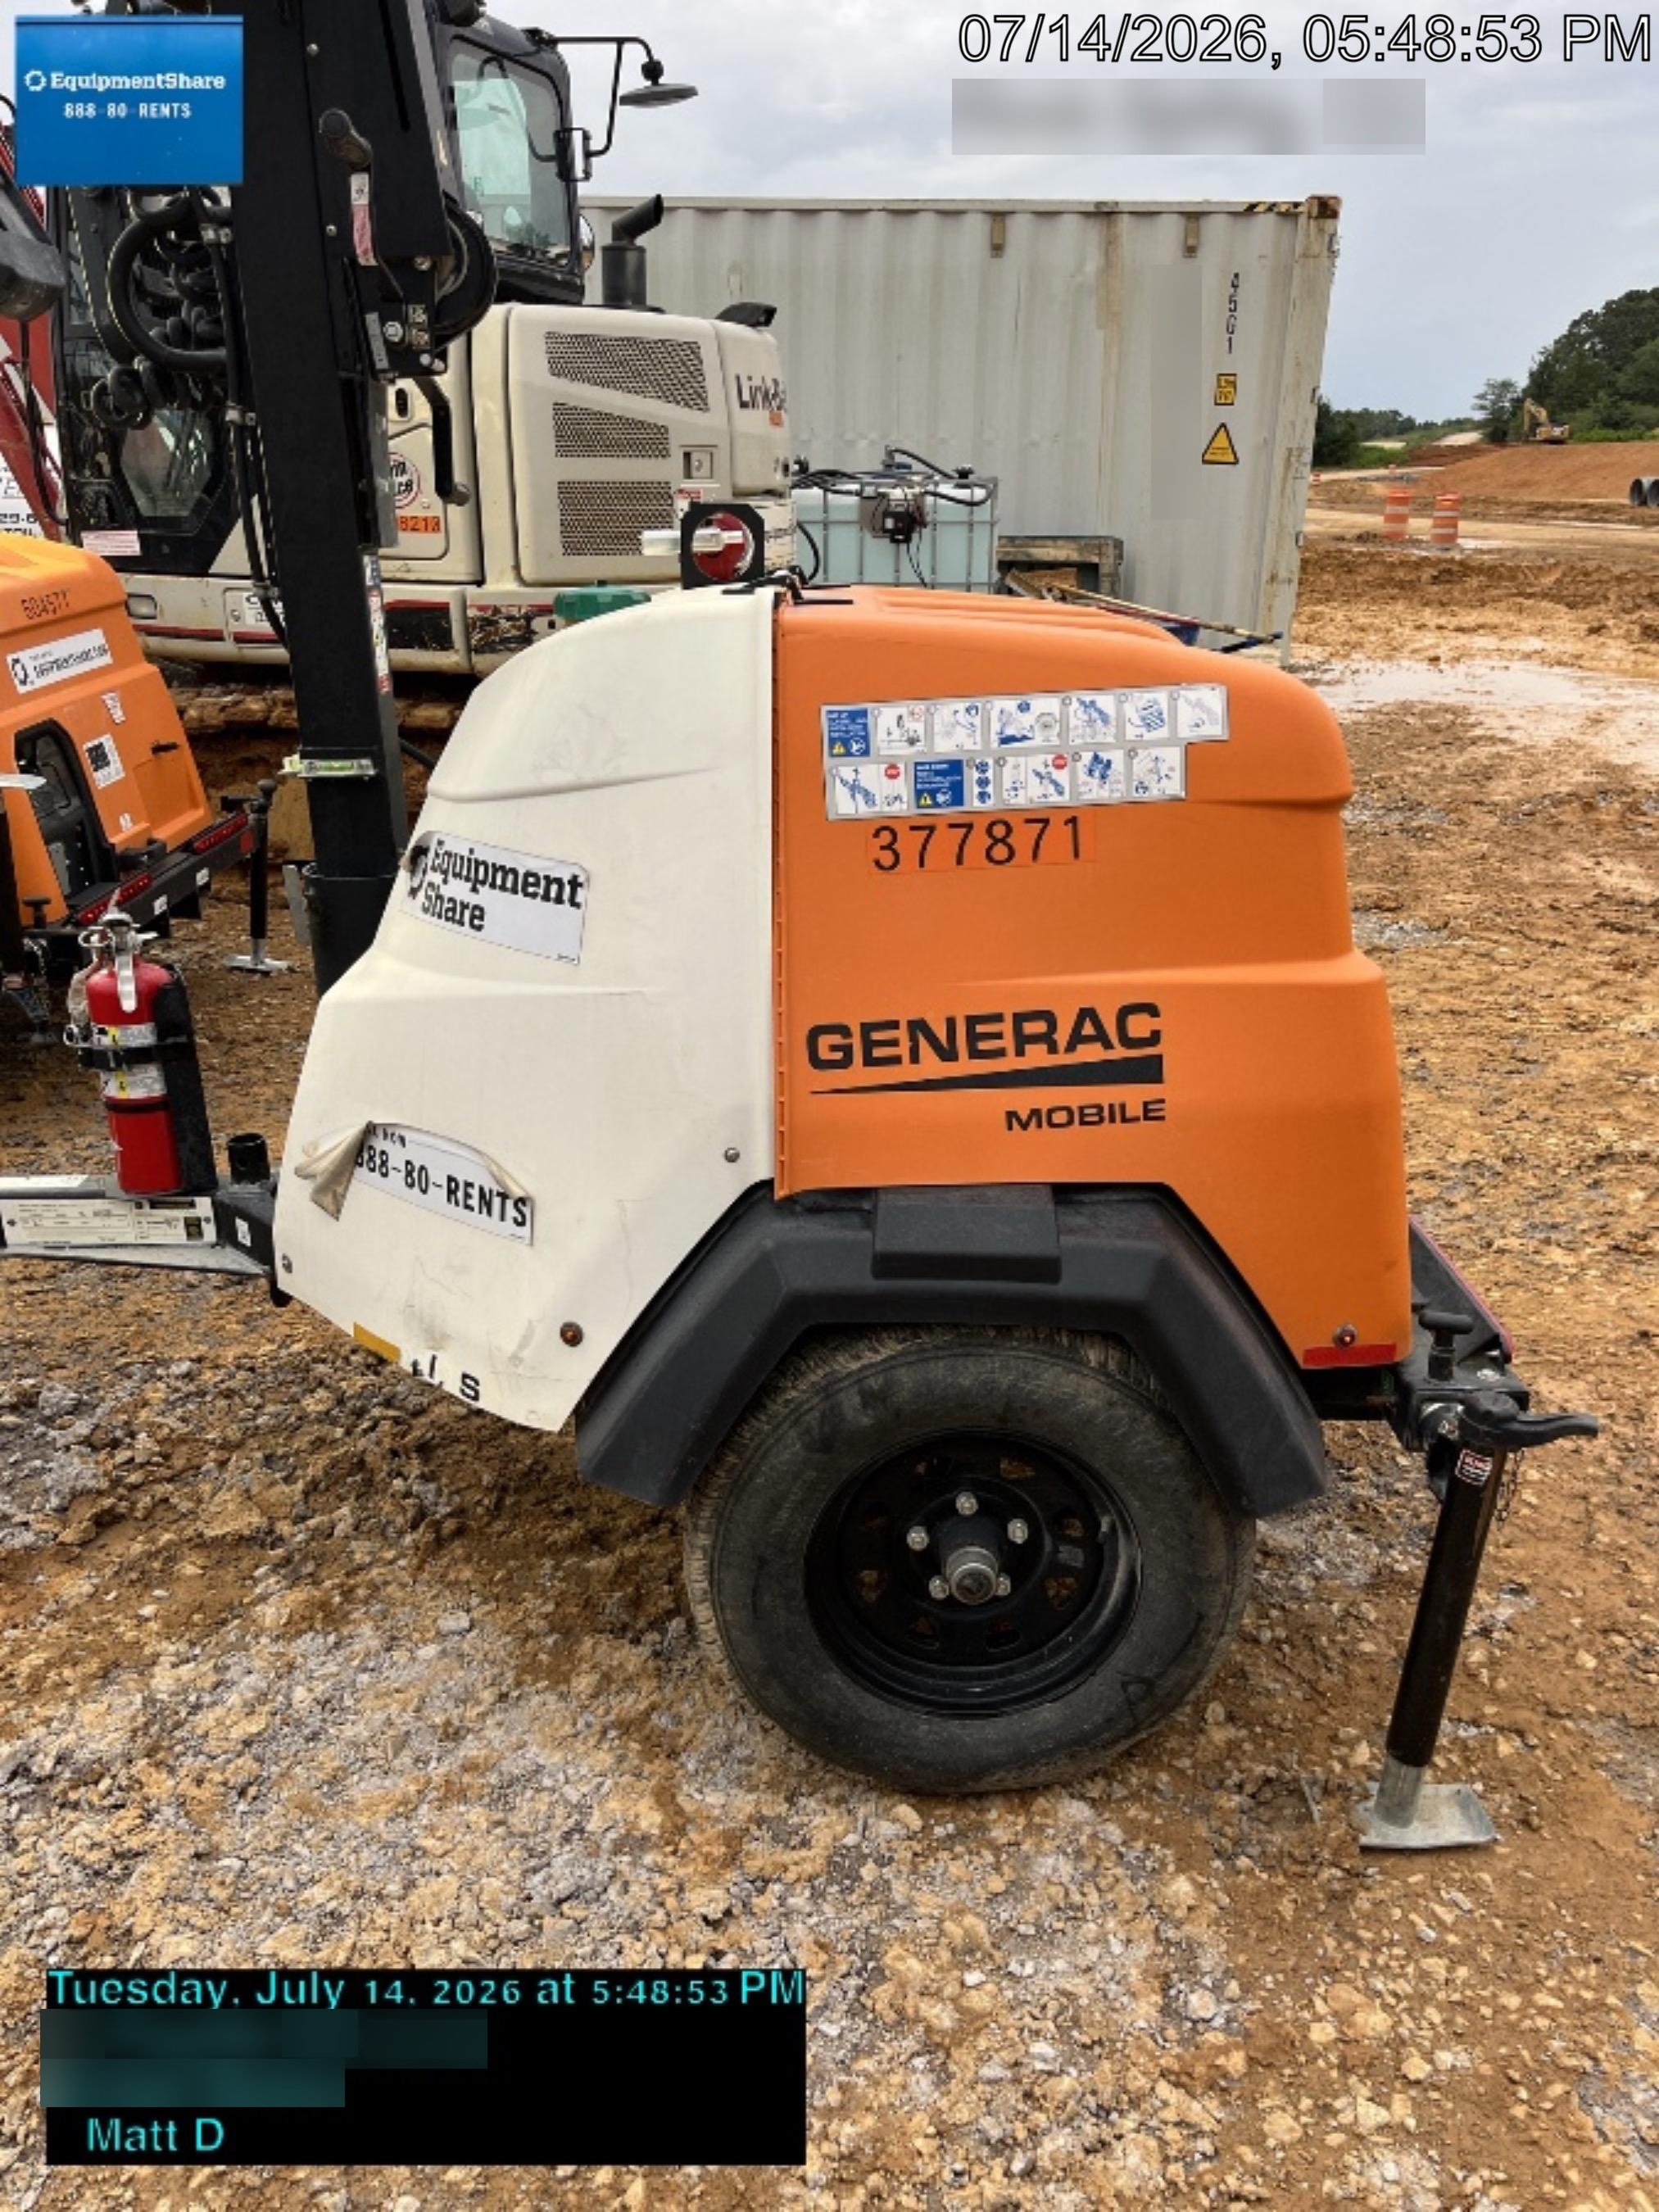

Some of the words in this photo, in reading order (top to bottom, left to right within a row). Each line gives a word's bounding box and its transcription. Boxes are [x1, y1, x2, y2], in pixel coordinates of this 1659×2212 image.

[872, 815, 1081, 871] 377871
[429, 838, 584, 909] Equipment
[421, 882, 487, 932] Share
[806, 1002, 1163, 1071] GENERAC
[1004, 1099, 1167, 1131] MOBILE
